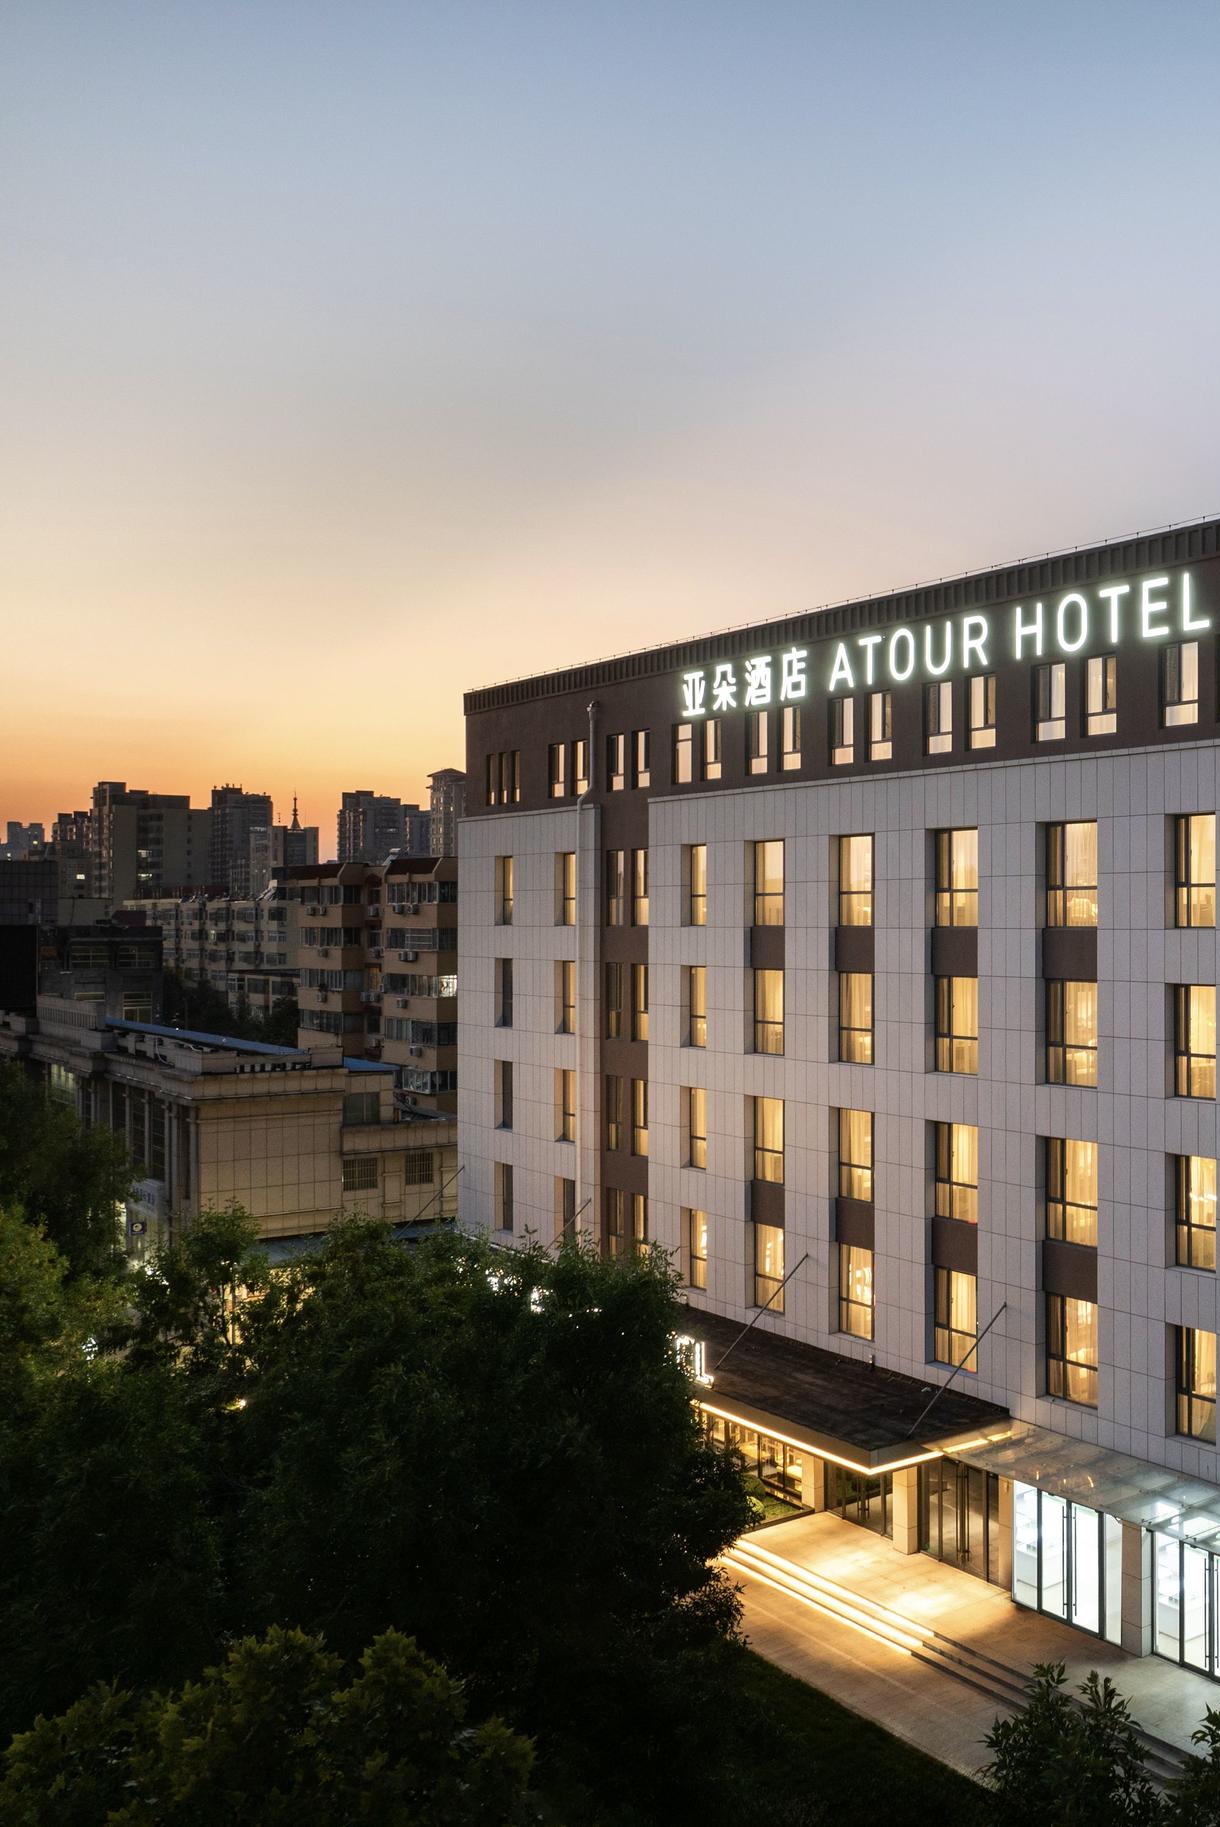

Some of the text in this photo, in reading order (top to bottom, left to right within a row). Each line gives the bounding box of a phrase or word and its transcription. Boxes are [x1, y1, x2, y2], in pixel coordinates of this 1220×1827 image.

[682, 572, 1210, 717] 亚朵酒店 ATOUR HOTEL
